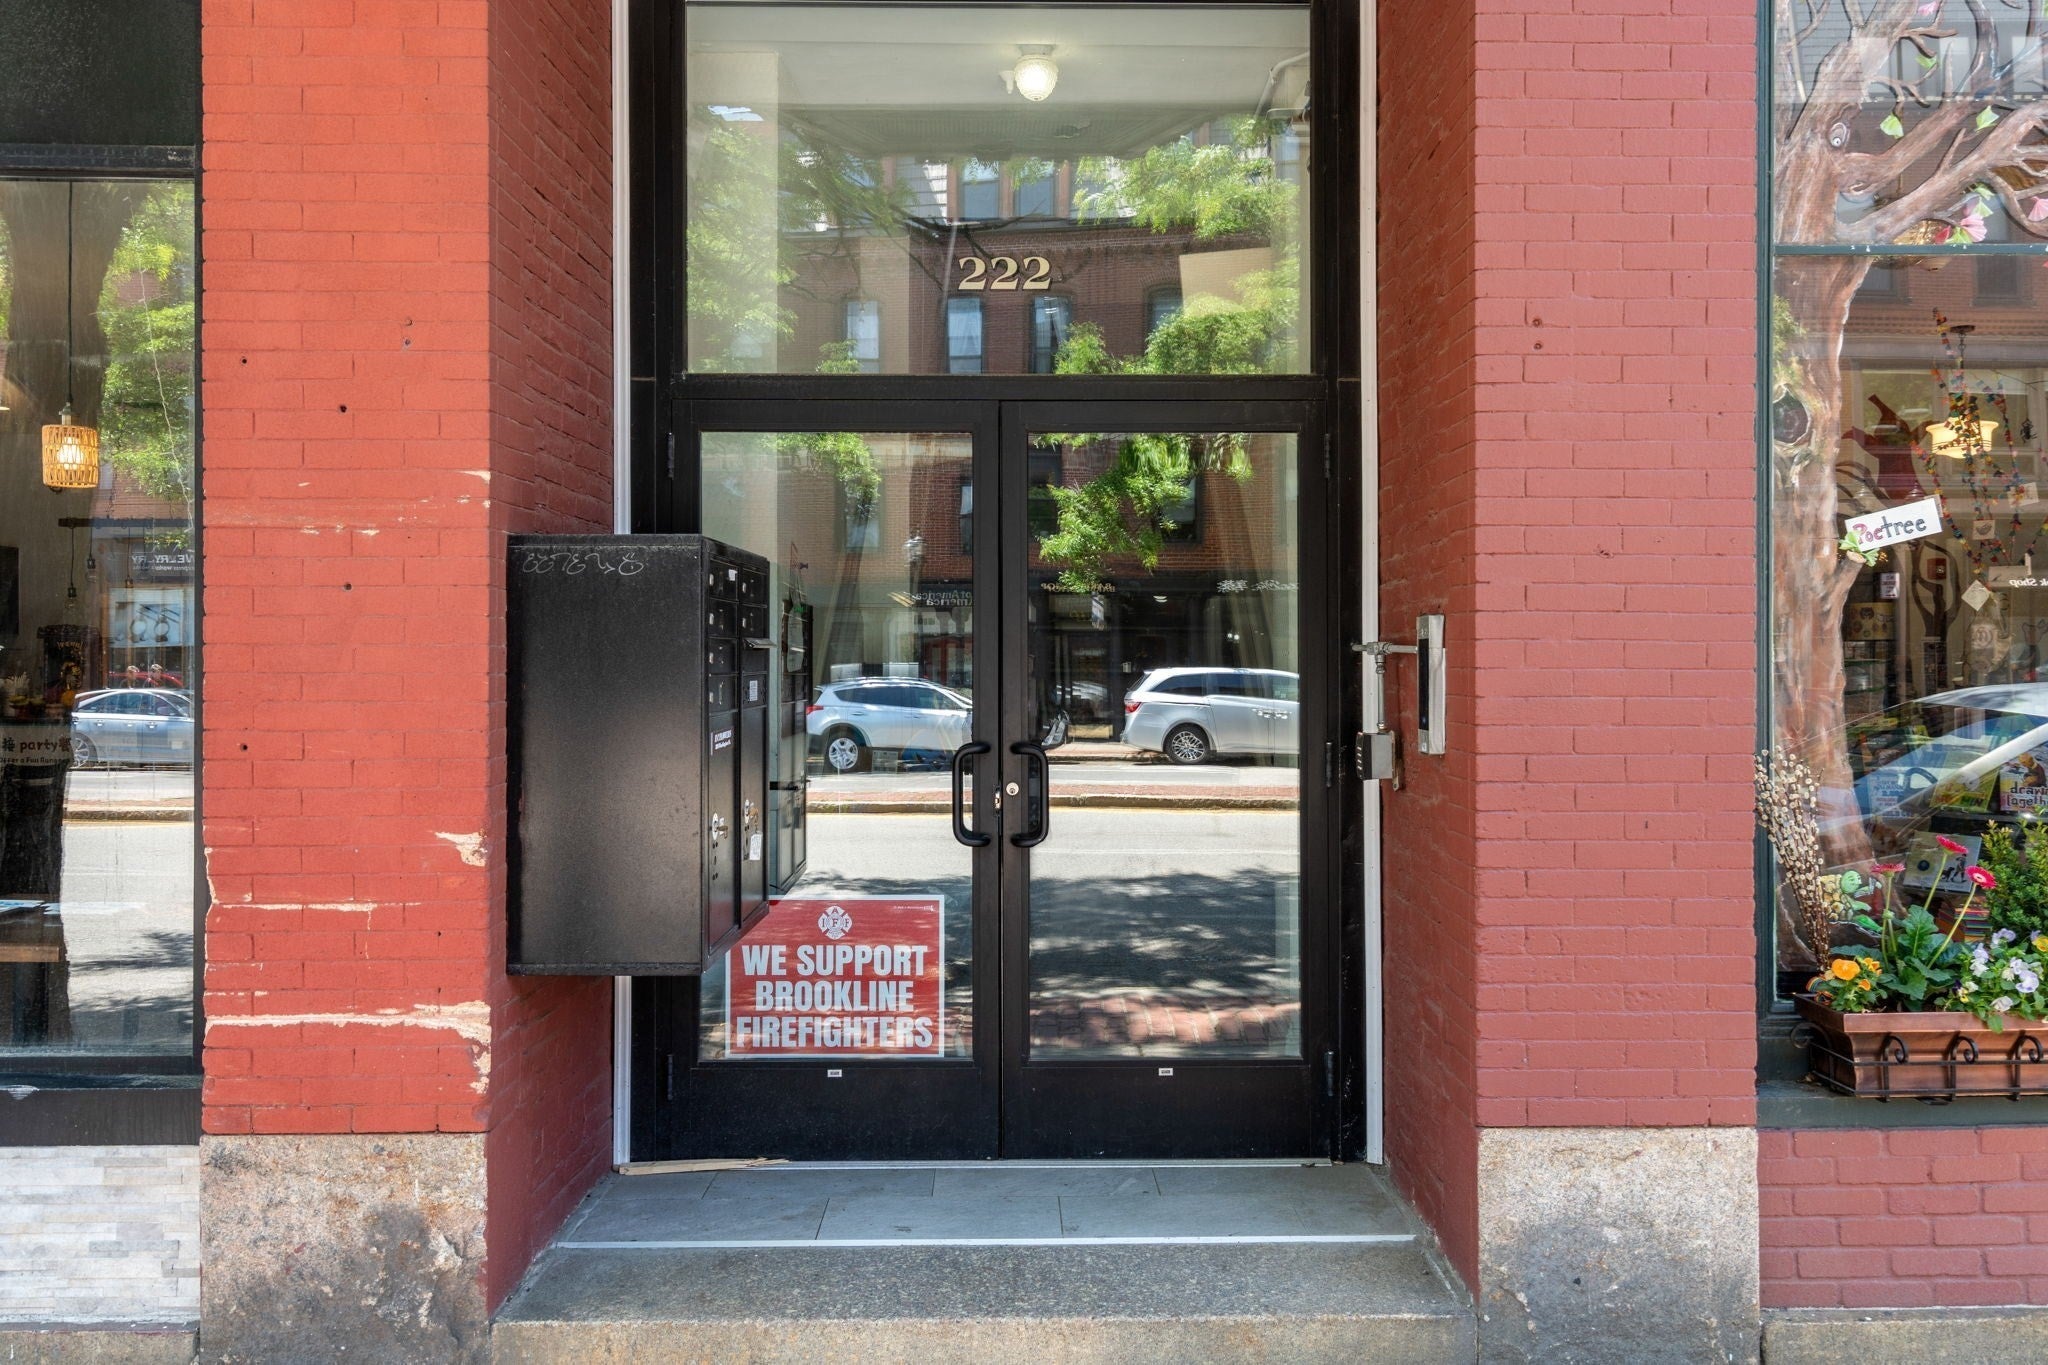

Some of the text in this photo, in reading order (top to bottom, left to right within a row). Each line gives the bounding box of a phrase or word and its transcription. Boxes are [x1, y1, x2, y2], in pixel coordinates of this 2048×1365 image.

[958, 256, 1051, 290] 222
[1852, 515, 1927, 545] Poetree
[742, 945, 928, 976] WE SUPPORT
[756, 981, 914, 1012] BROOKLINE
[736, 1016, 933, 1048] FIREFIGHTERS
